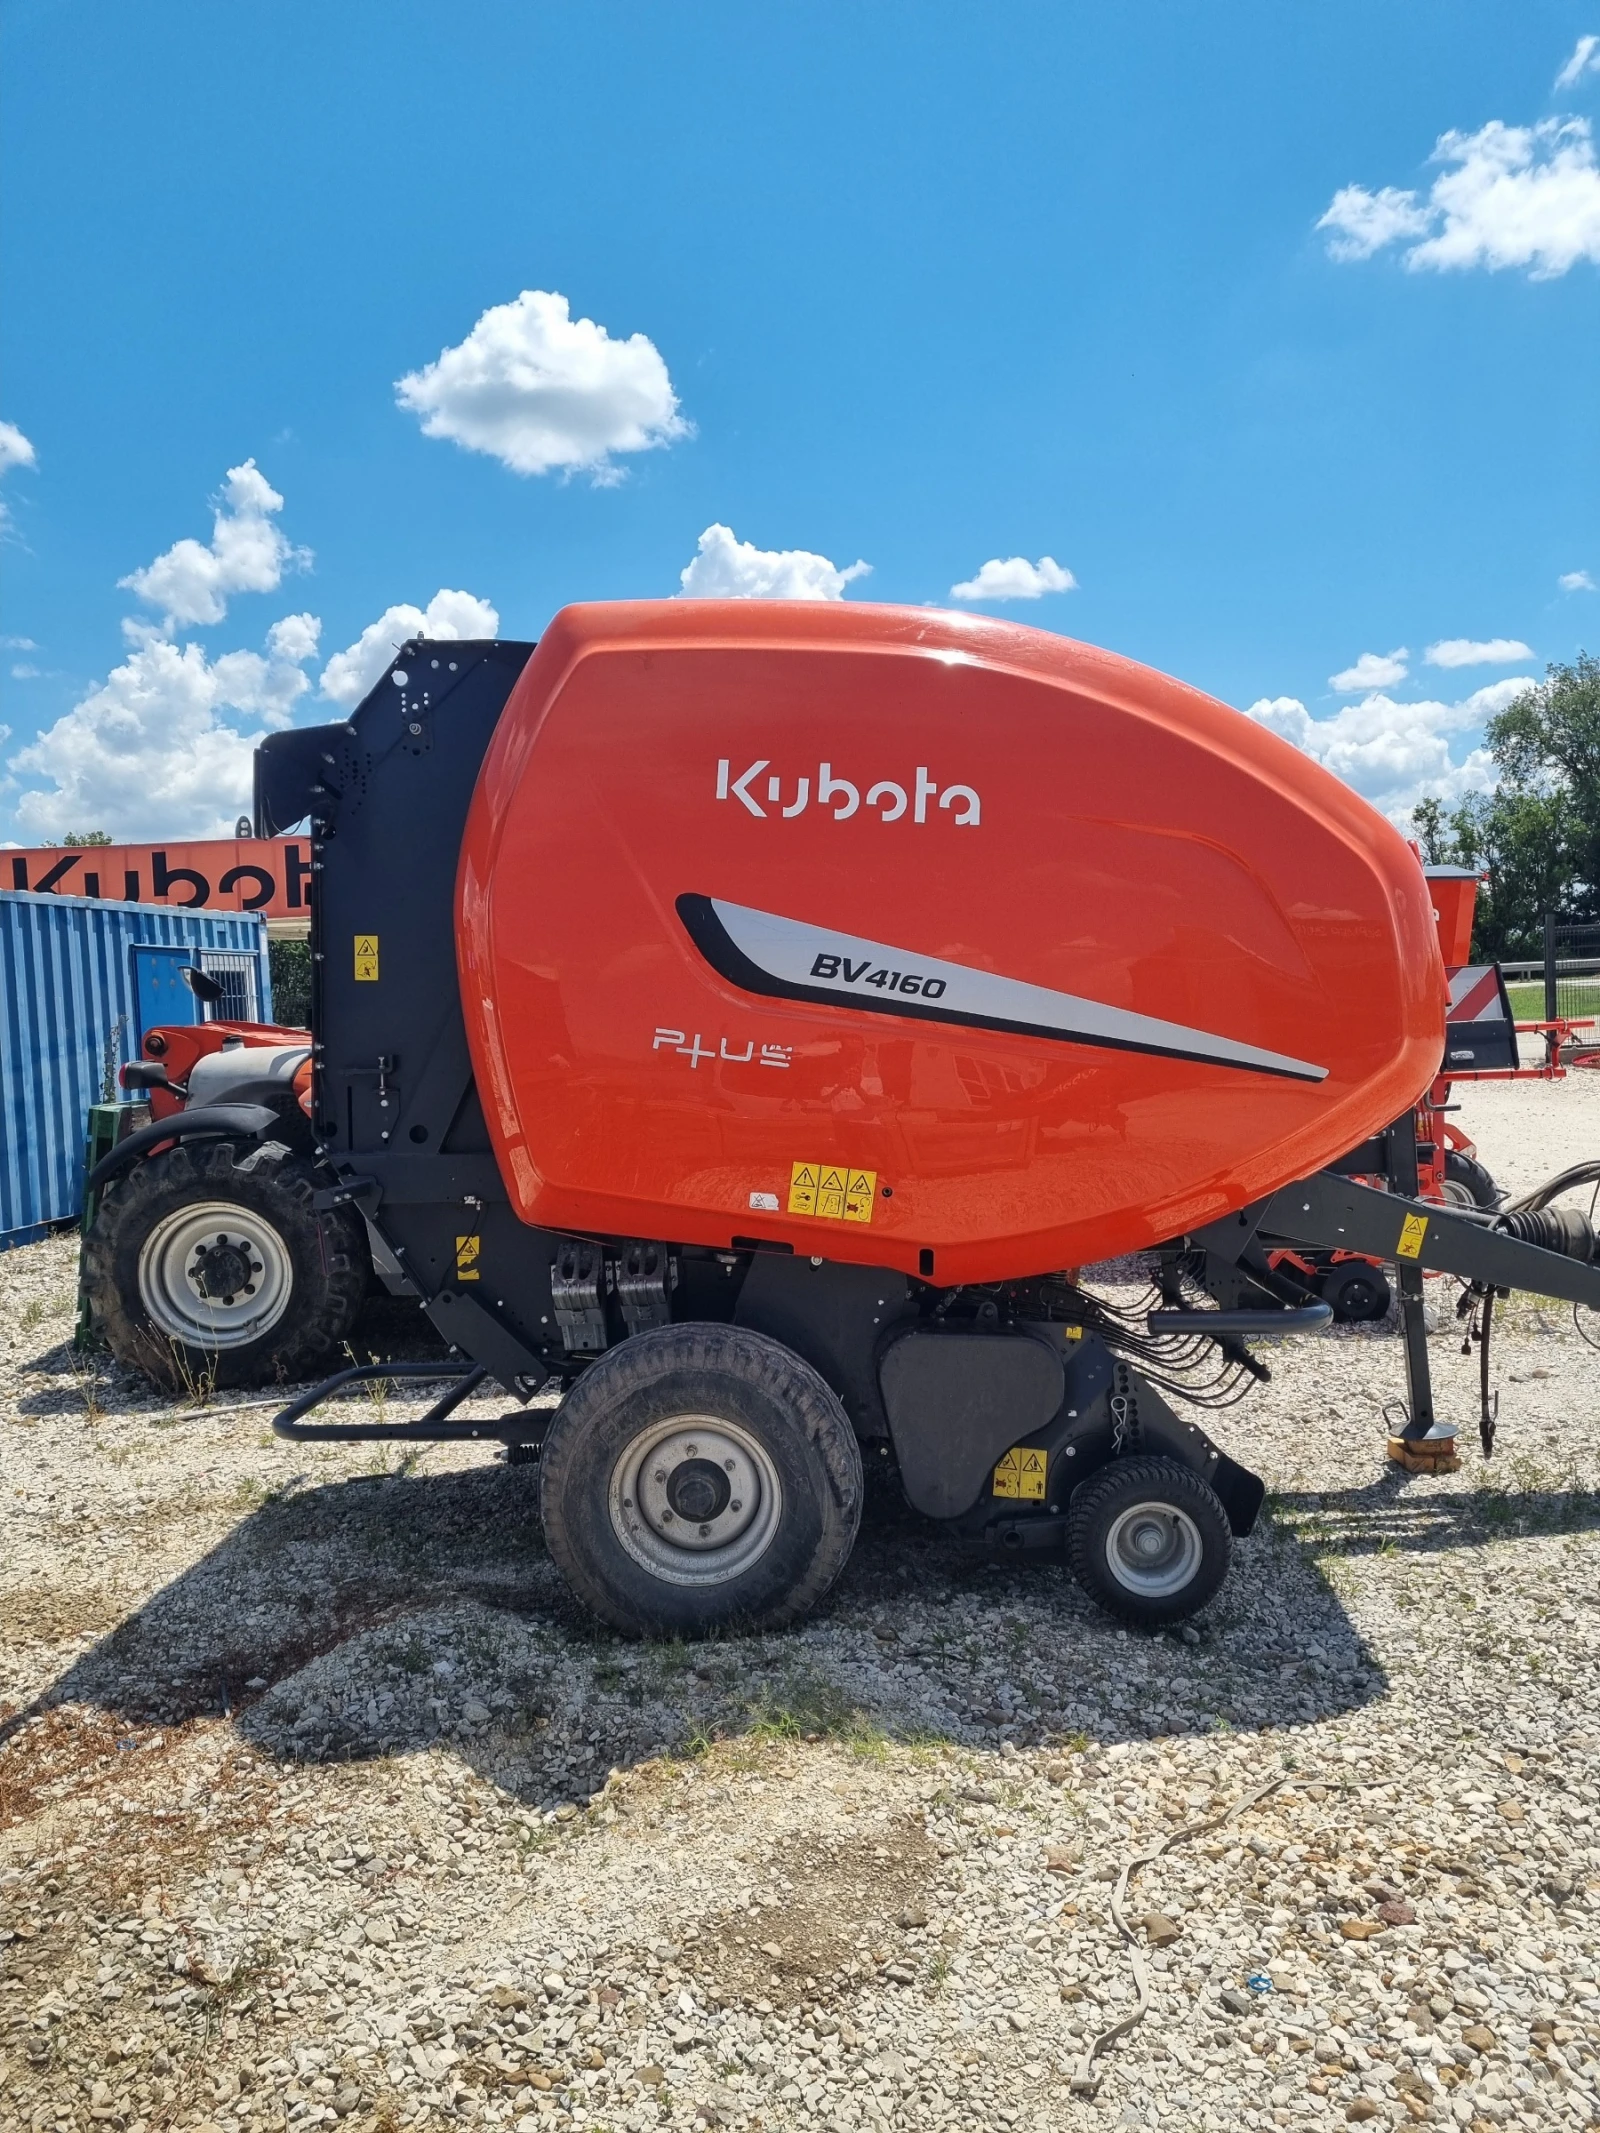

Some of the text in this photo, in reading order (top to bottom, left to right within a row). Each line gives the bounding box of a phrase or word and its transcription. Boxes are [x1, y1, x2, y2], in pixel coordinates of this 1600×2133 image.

[716, 758, 981, 826] Kubota
[12, 844, 312, 911] Kubot
[809, 953, 947, 999] BV4160
